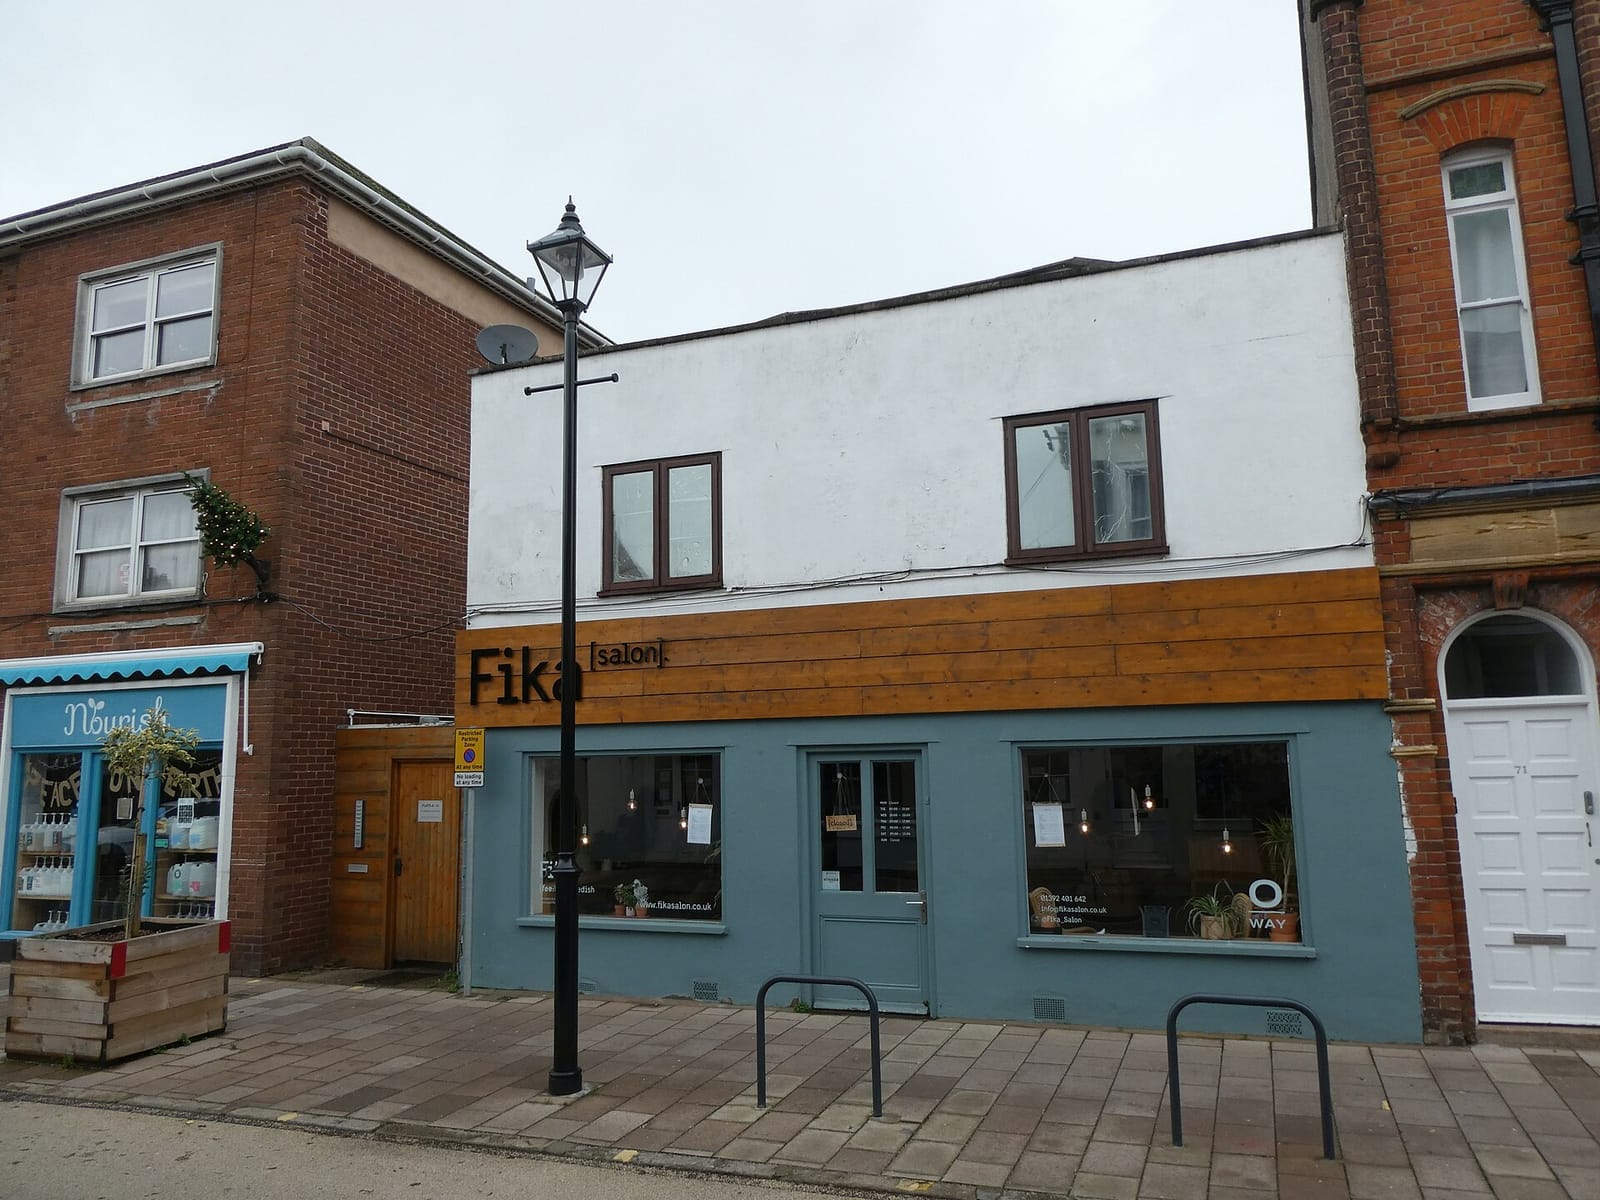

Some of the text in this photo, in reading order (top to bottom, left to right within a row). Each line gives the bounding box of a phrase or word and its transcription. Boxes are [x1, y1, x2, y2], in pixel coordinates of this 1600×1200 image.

[1513, 765, 1528, 775] 71
[1074, 895, 1087, 903] 642
[1248, 918, 1286, 930] WAY
